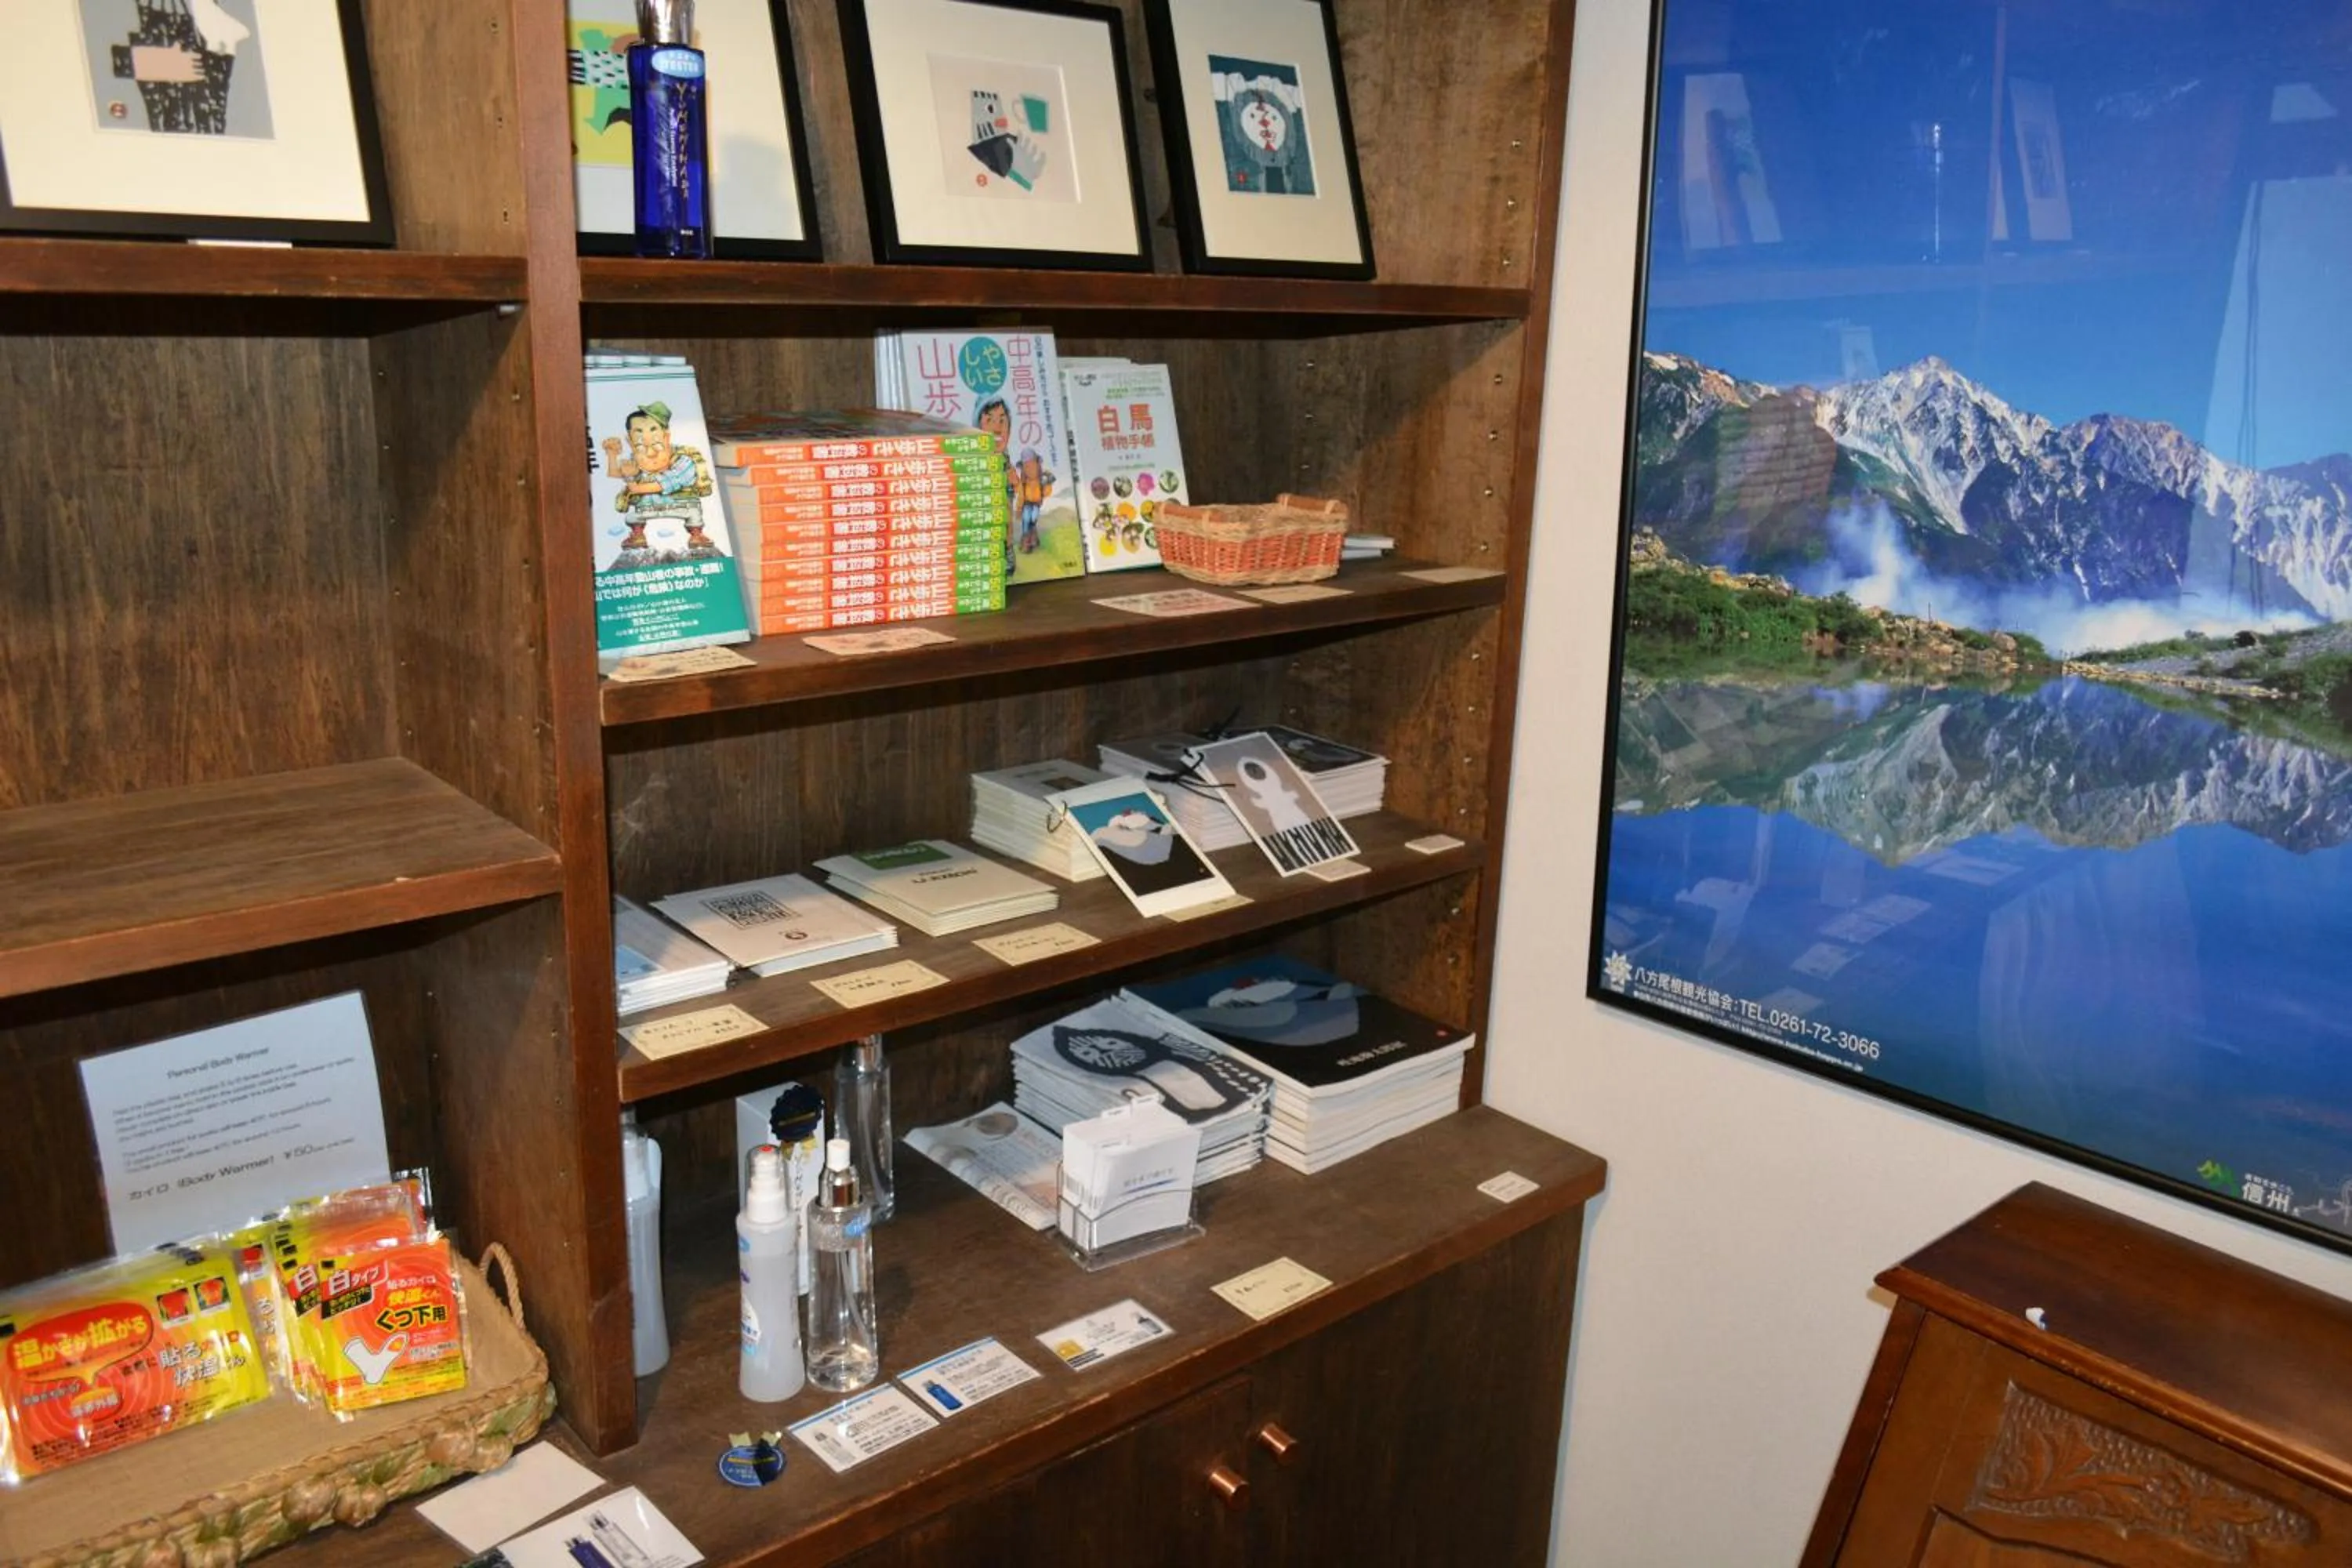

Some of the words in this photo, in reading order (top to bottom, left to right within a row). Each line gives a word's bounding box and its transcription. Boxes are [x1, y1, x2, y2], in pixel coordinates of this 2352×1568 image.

[1007, 336, 1044, 446] 中高年の
[166, 1062, 209, 1080] Personal
[209, 1056, 234, 1070] Body
[234, 1047, 270, 1062] Warmer
[129, 1183, 170, 1201] カイロ
[376, 1304, 448, 1331] くつ下用
